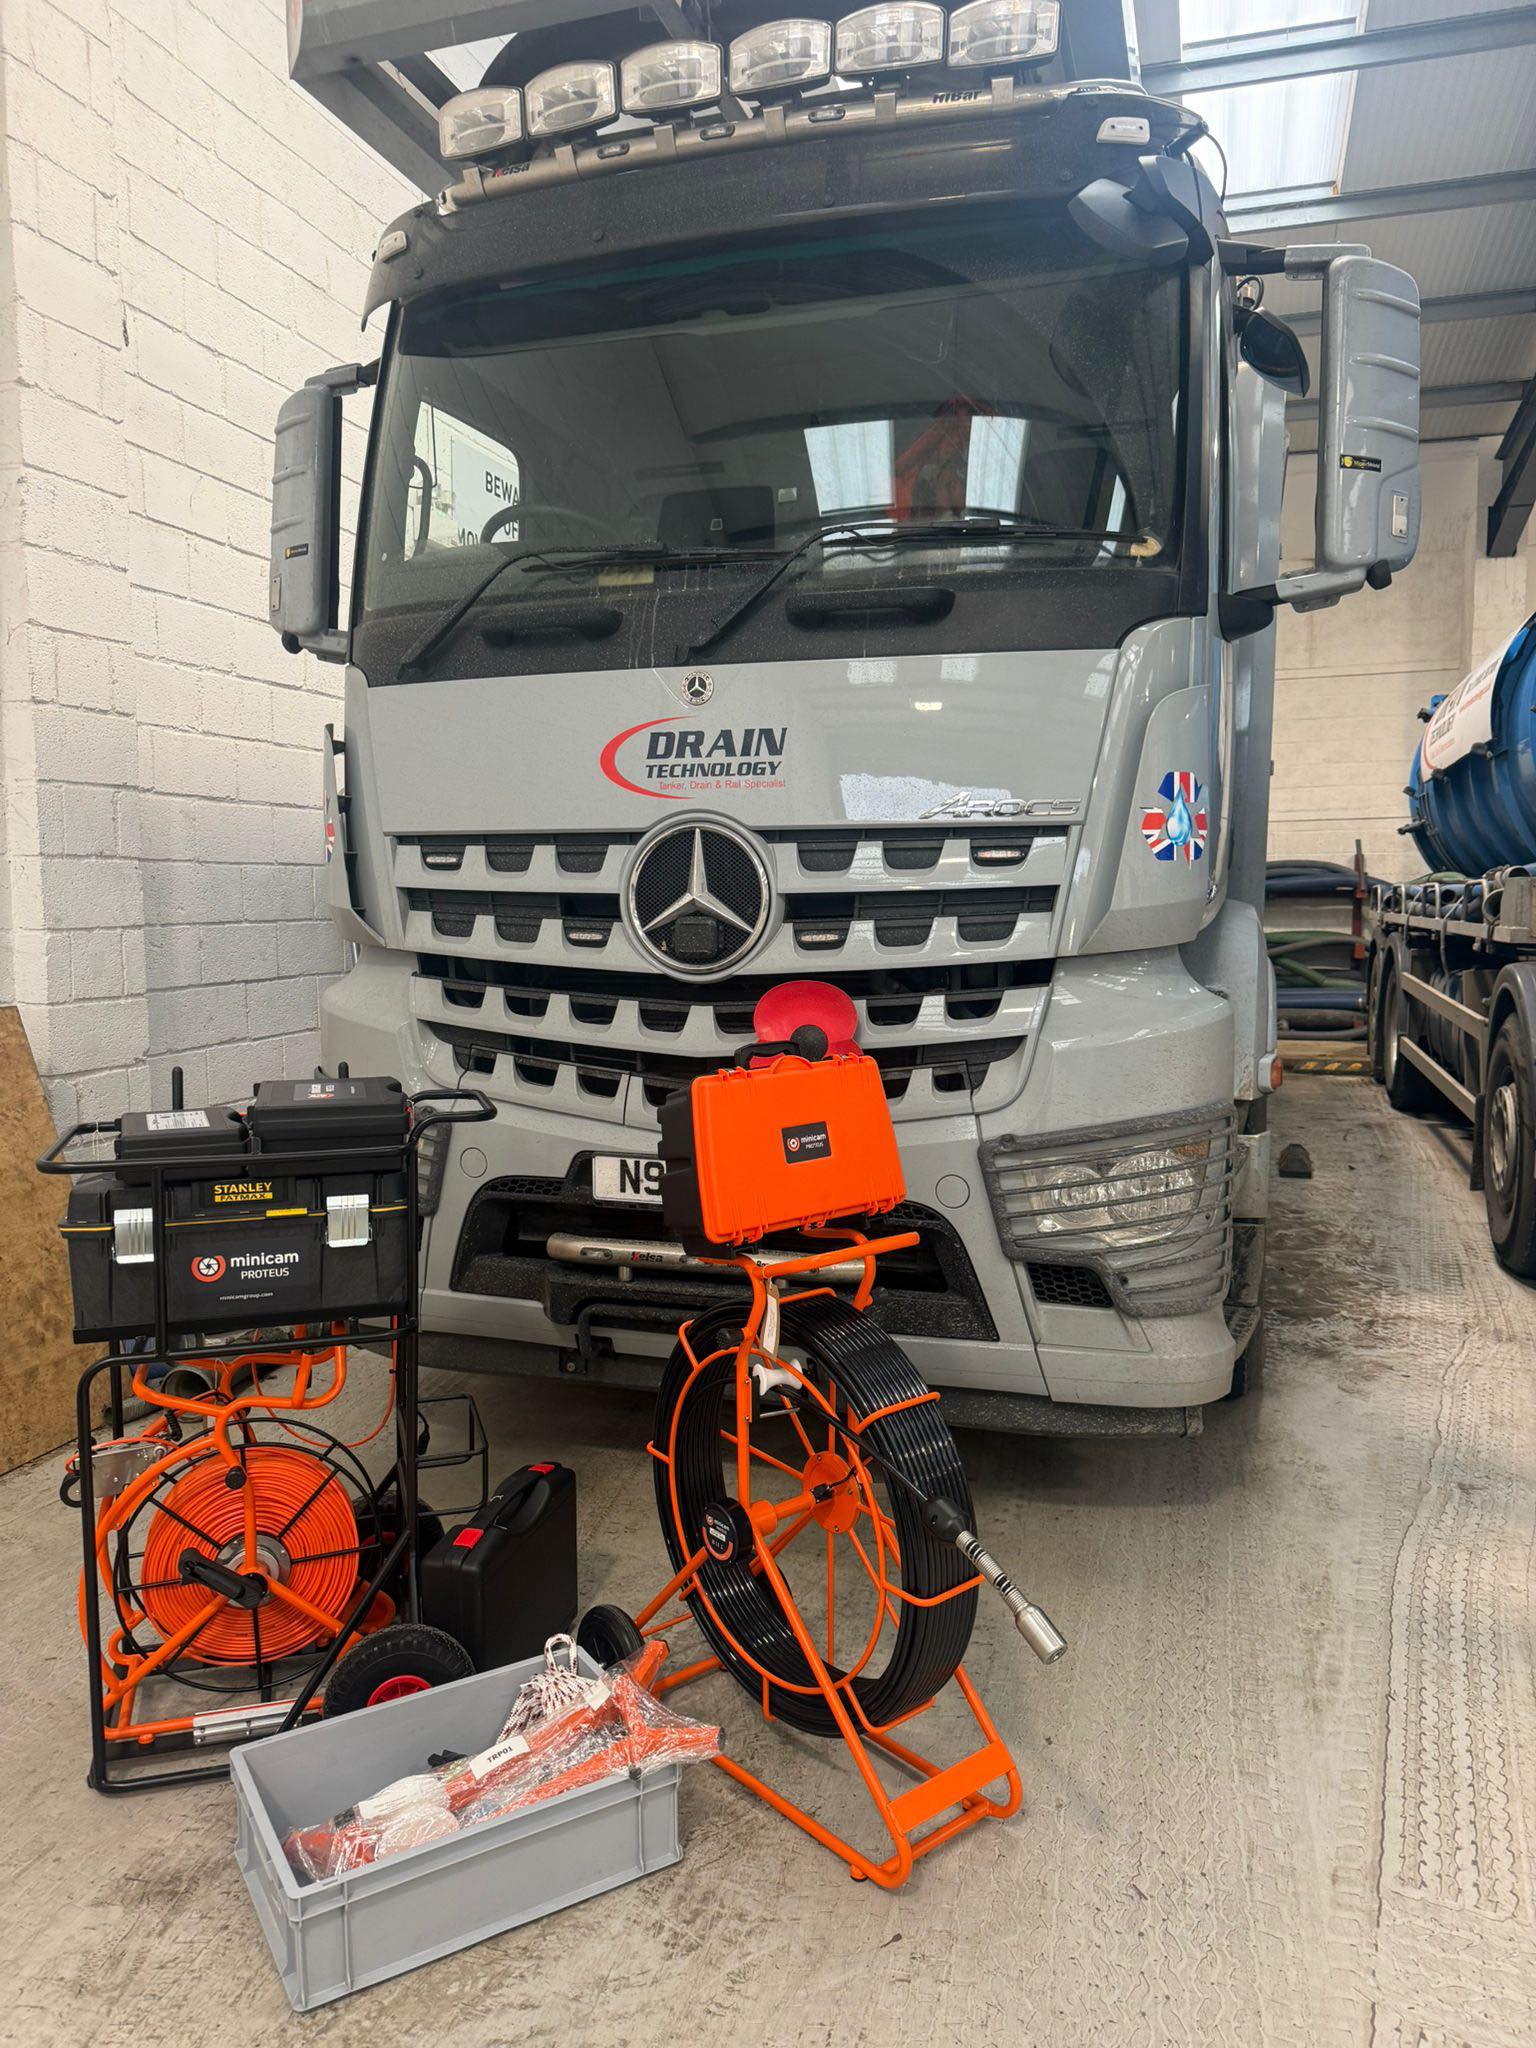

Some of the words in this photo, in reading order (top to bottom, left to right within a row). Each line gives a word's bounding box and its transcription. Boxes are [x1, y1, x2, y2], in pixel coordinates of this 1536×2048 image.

[646, 727, 788, 760] DRAIN
[645, 761, 782, 779] TECHNOLOGY
[659, 781, 687, 792] Tanker,
[689, 780, 712, 790] Drain
[715, 781, 722, 789] &
[725, 780, 741, 789] Rail
[744, 779, 786, 790] Specialist
[801, 1133, 827, 1144] minicam
[214, 1182, 272, 1194] STANLEY
[219, 1193, 267, 1202] FATMAX
[230, 1251, 300, 1268] minicam
[631, 1251, 663, 1263] Kelsa
[240, 1267, 290, 1280] PROTEUS
[487, 1746, 513, 1763] TRP01
